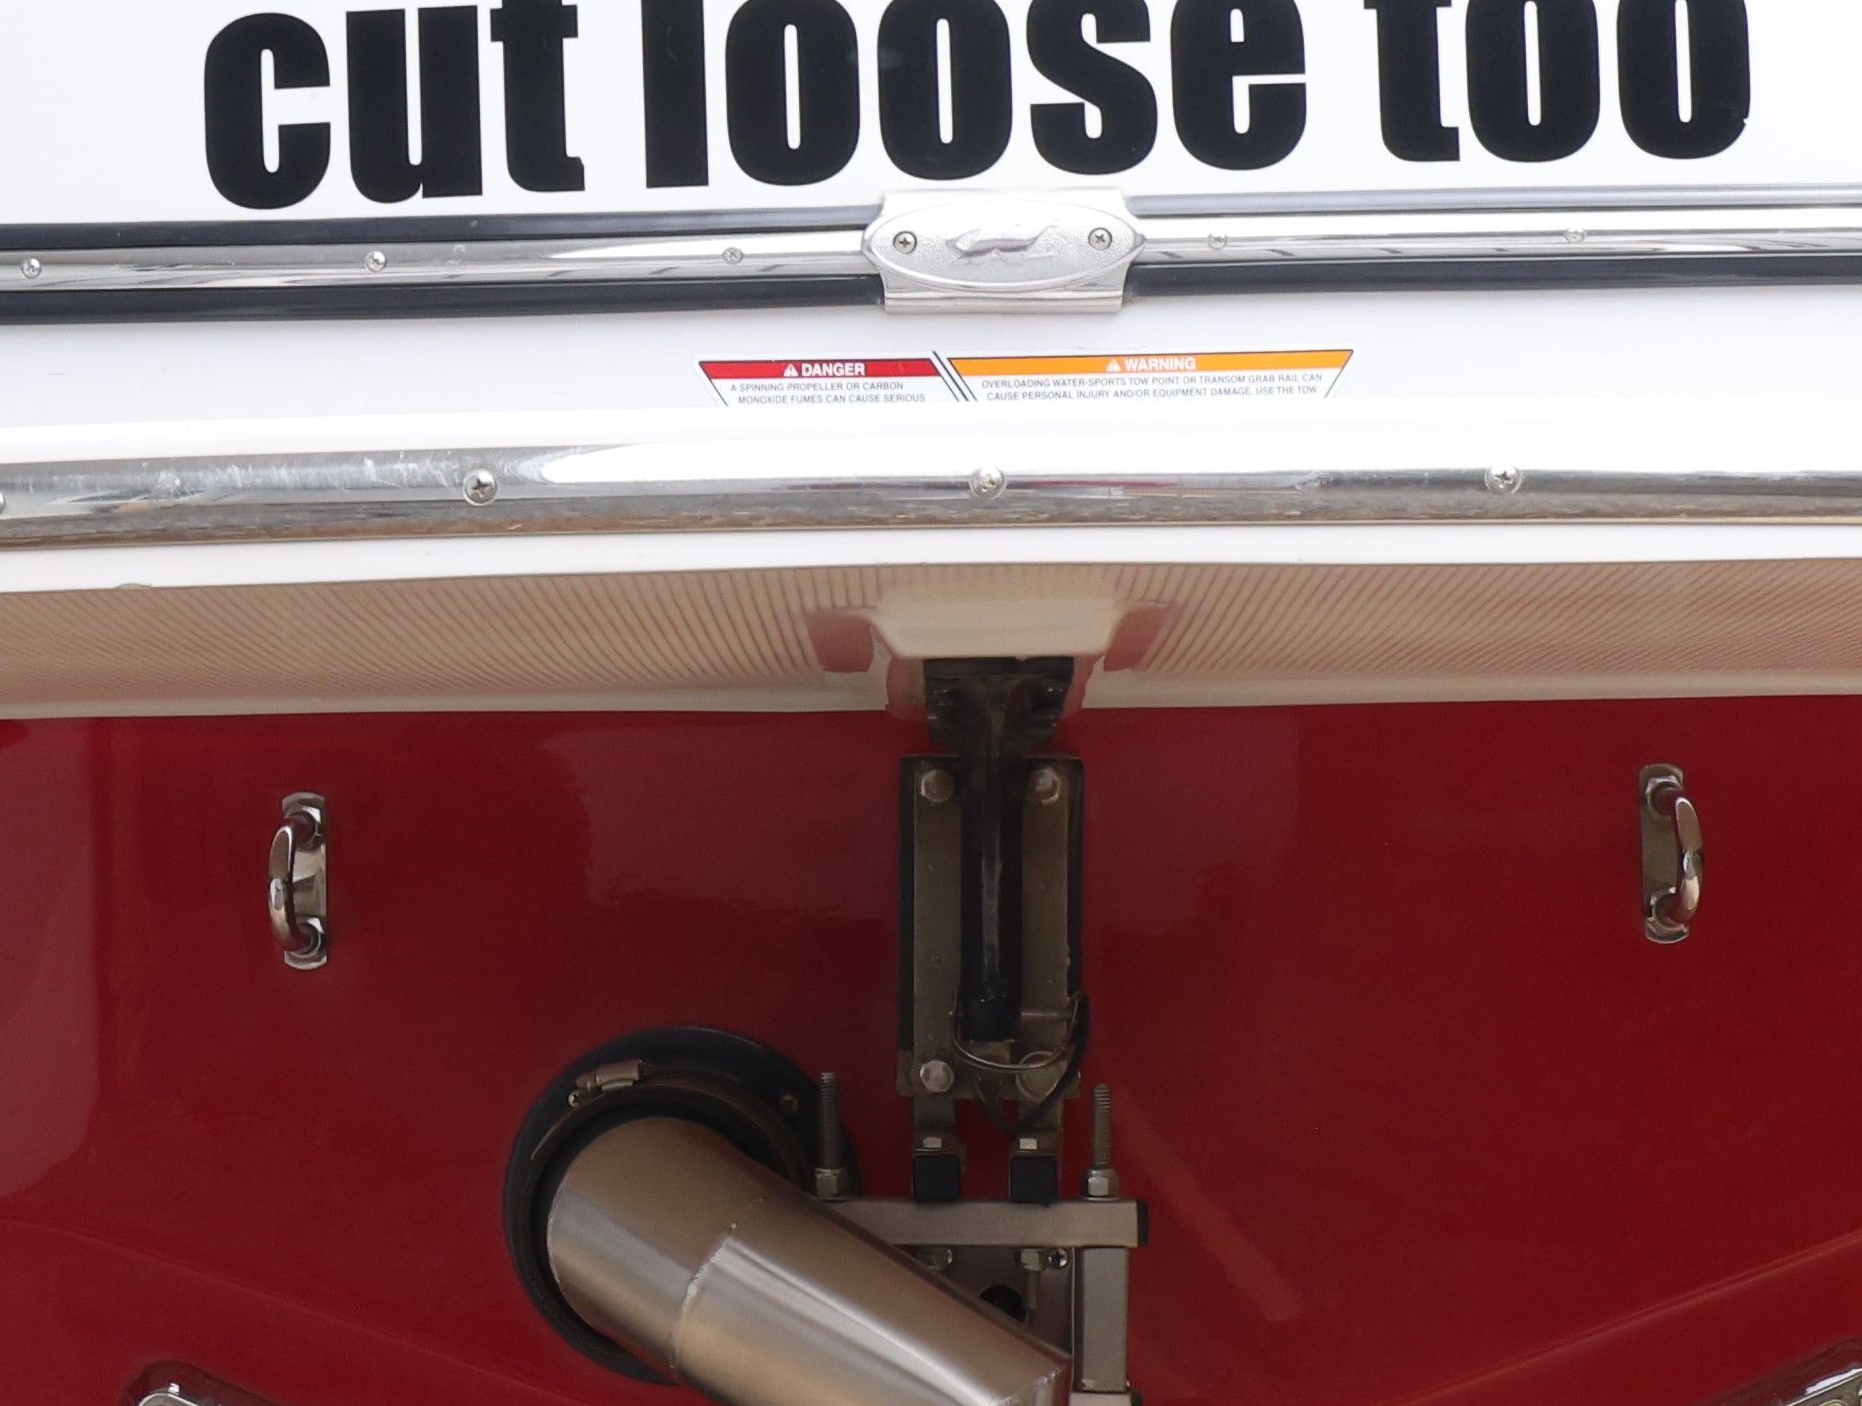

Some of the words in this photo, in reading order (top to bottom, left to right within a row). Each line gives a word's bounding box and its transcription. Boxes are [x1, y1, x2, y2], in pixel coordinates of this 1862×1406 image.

[801, 362, 866, 377] DANGER
[1124, 357, 1197, 372] WARNING
[730, 383, 737, 392] A
[739, 383, 785, 392] SPINNING
[787, 382, 844, 392] PROPELLER
[845, 382, 860, 391] OR
[862, 381, 904, 391] CARBON
[981, 379, 1051, 389] OVERLOADING
[1052, 377, 1127, 388] WATER-SPORTS
[1128, 377, 1149, 386] TOW
[1151, 376, 1180, 385] POINT
[1182, 376, 1197, 385] OR
[1199, 375, 1246, 384] TRANSOM
[1248, 374, 1276, 384] GRAB
[1278, 374, 1300, 383] RAIL
[1302, 373, 1323, 382] CAN
[738, 395, 788, 404] MONOXIDE
[790, 394, 824, 404] FUMES
[825, 394, 846, 403] CAN
[848, 393, 881, 403] CAUSE
[883, 393, 927, 403] SERIOUS
[986, 392, 1020, 402] CAUSE
[1022, 391, 1074, 401] PERSONAL
[1076, 390, 1110, 399] INJURY
[1113, 389, 1151, 398] AND/OR
[1152, 388, 1208, 397] EQUIPMENT
[1255, 386, 1275, 395] USE
[1276, 385, 1295, 394] THE
[1297, 385, 1318, 394] TOW
